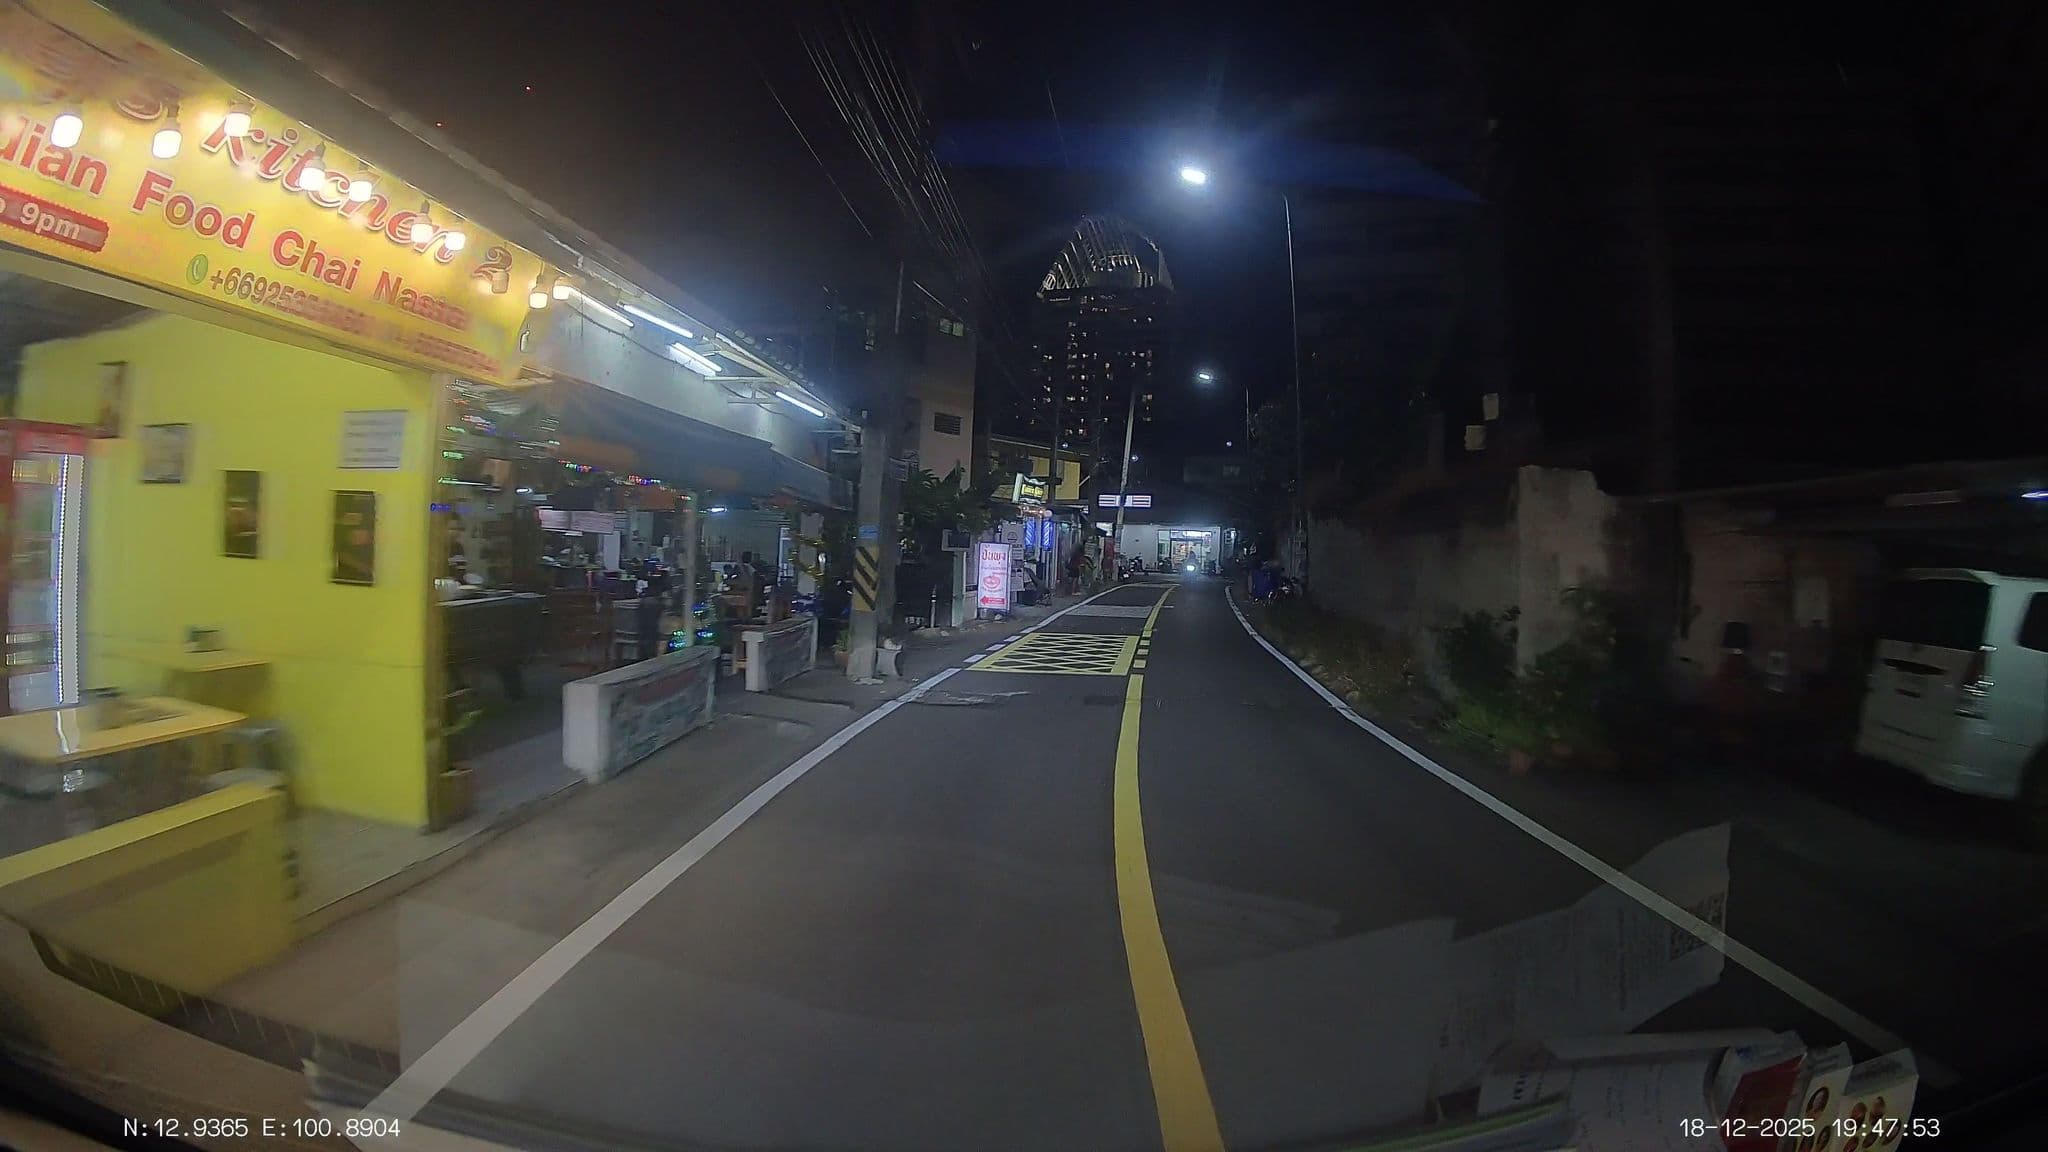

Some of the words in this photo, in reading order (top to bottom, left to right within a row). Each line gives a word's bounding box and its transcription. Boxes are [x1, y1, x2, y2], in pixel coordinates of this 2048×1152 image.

[20, 202, 81, 241] 9pm
[132, 170, 255, 249] Food
[272, 229, 362, 290] Chai
[473, 245, 514, 281] 2
